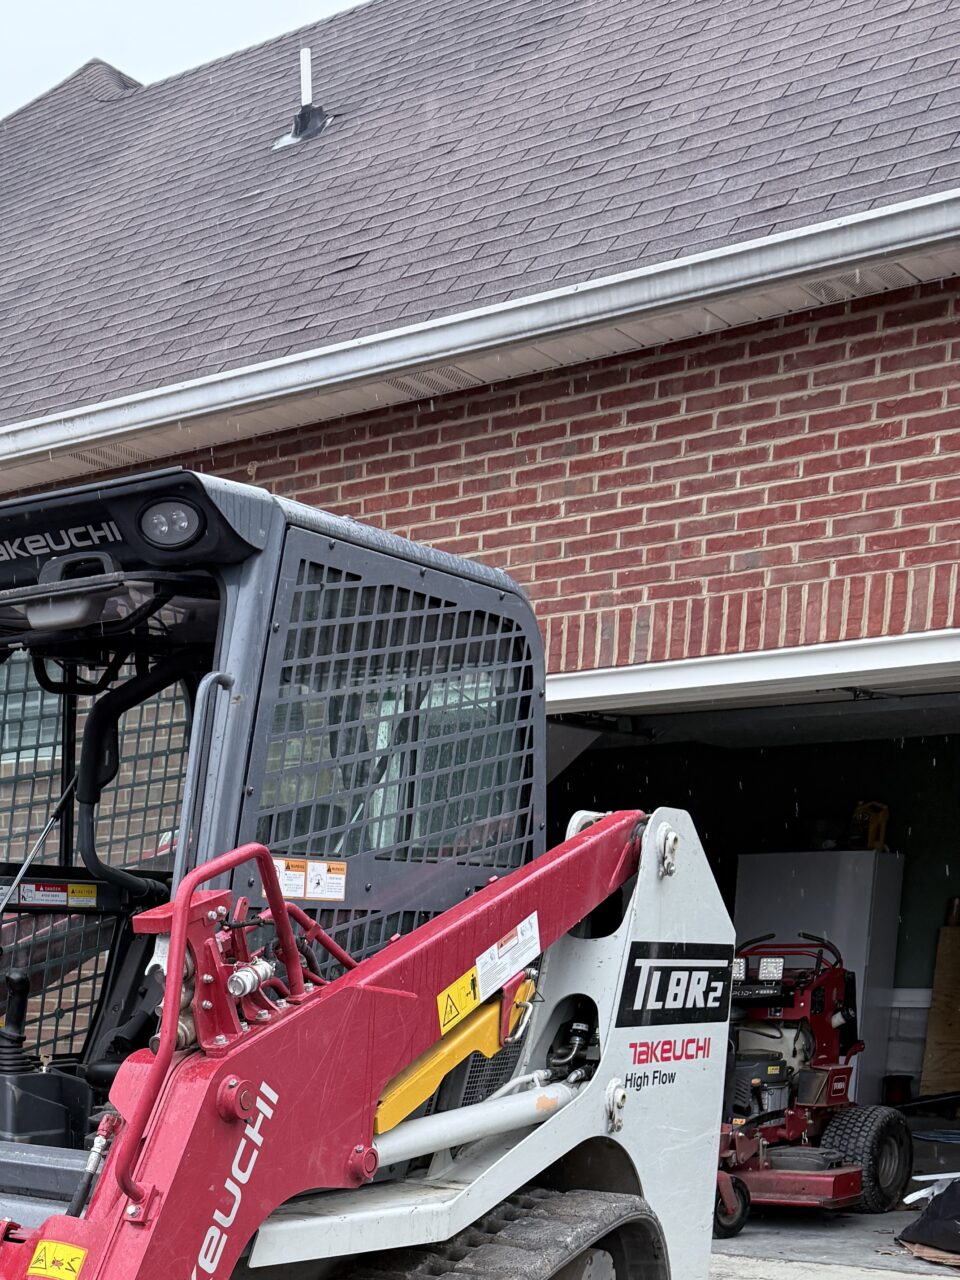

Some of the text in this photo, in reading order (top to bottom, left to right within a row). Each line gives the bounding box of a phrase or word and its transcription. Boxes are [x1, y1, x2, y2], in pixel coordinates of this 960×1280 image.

[629, 1037, 711, 1065] TAKEUCHI
[624, 1069, 677, 1091] High Flow
